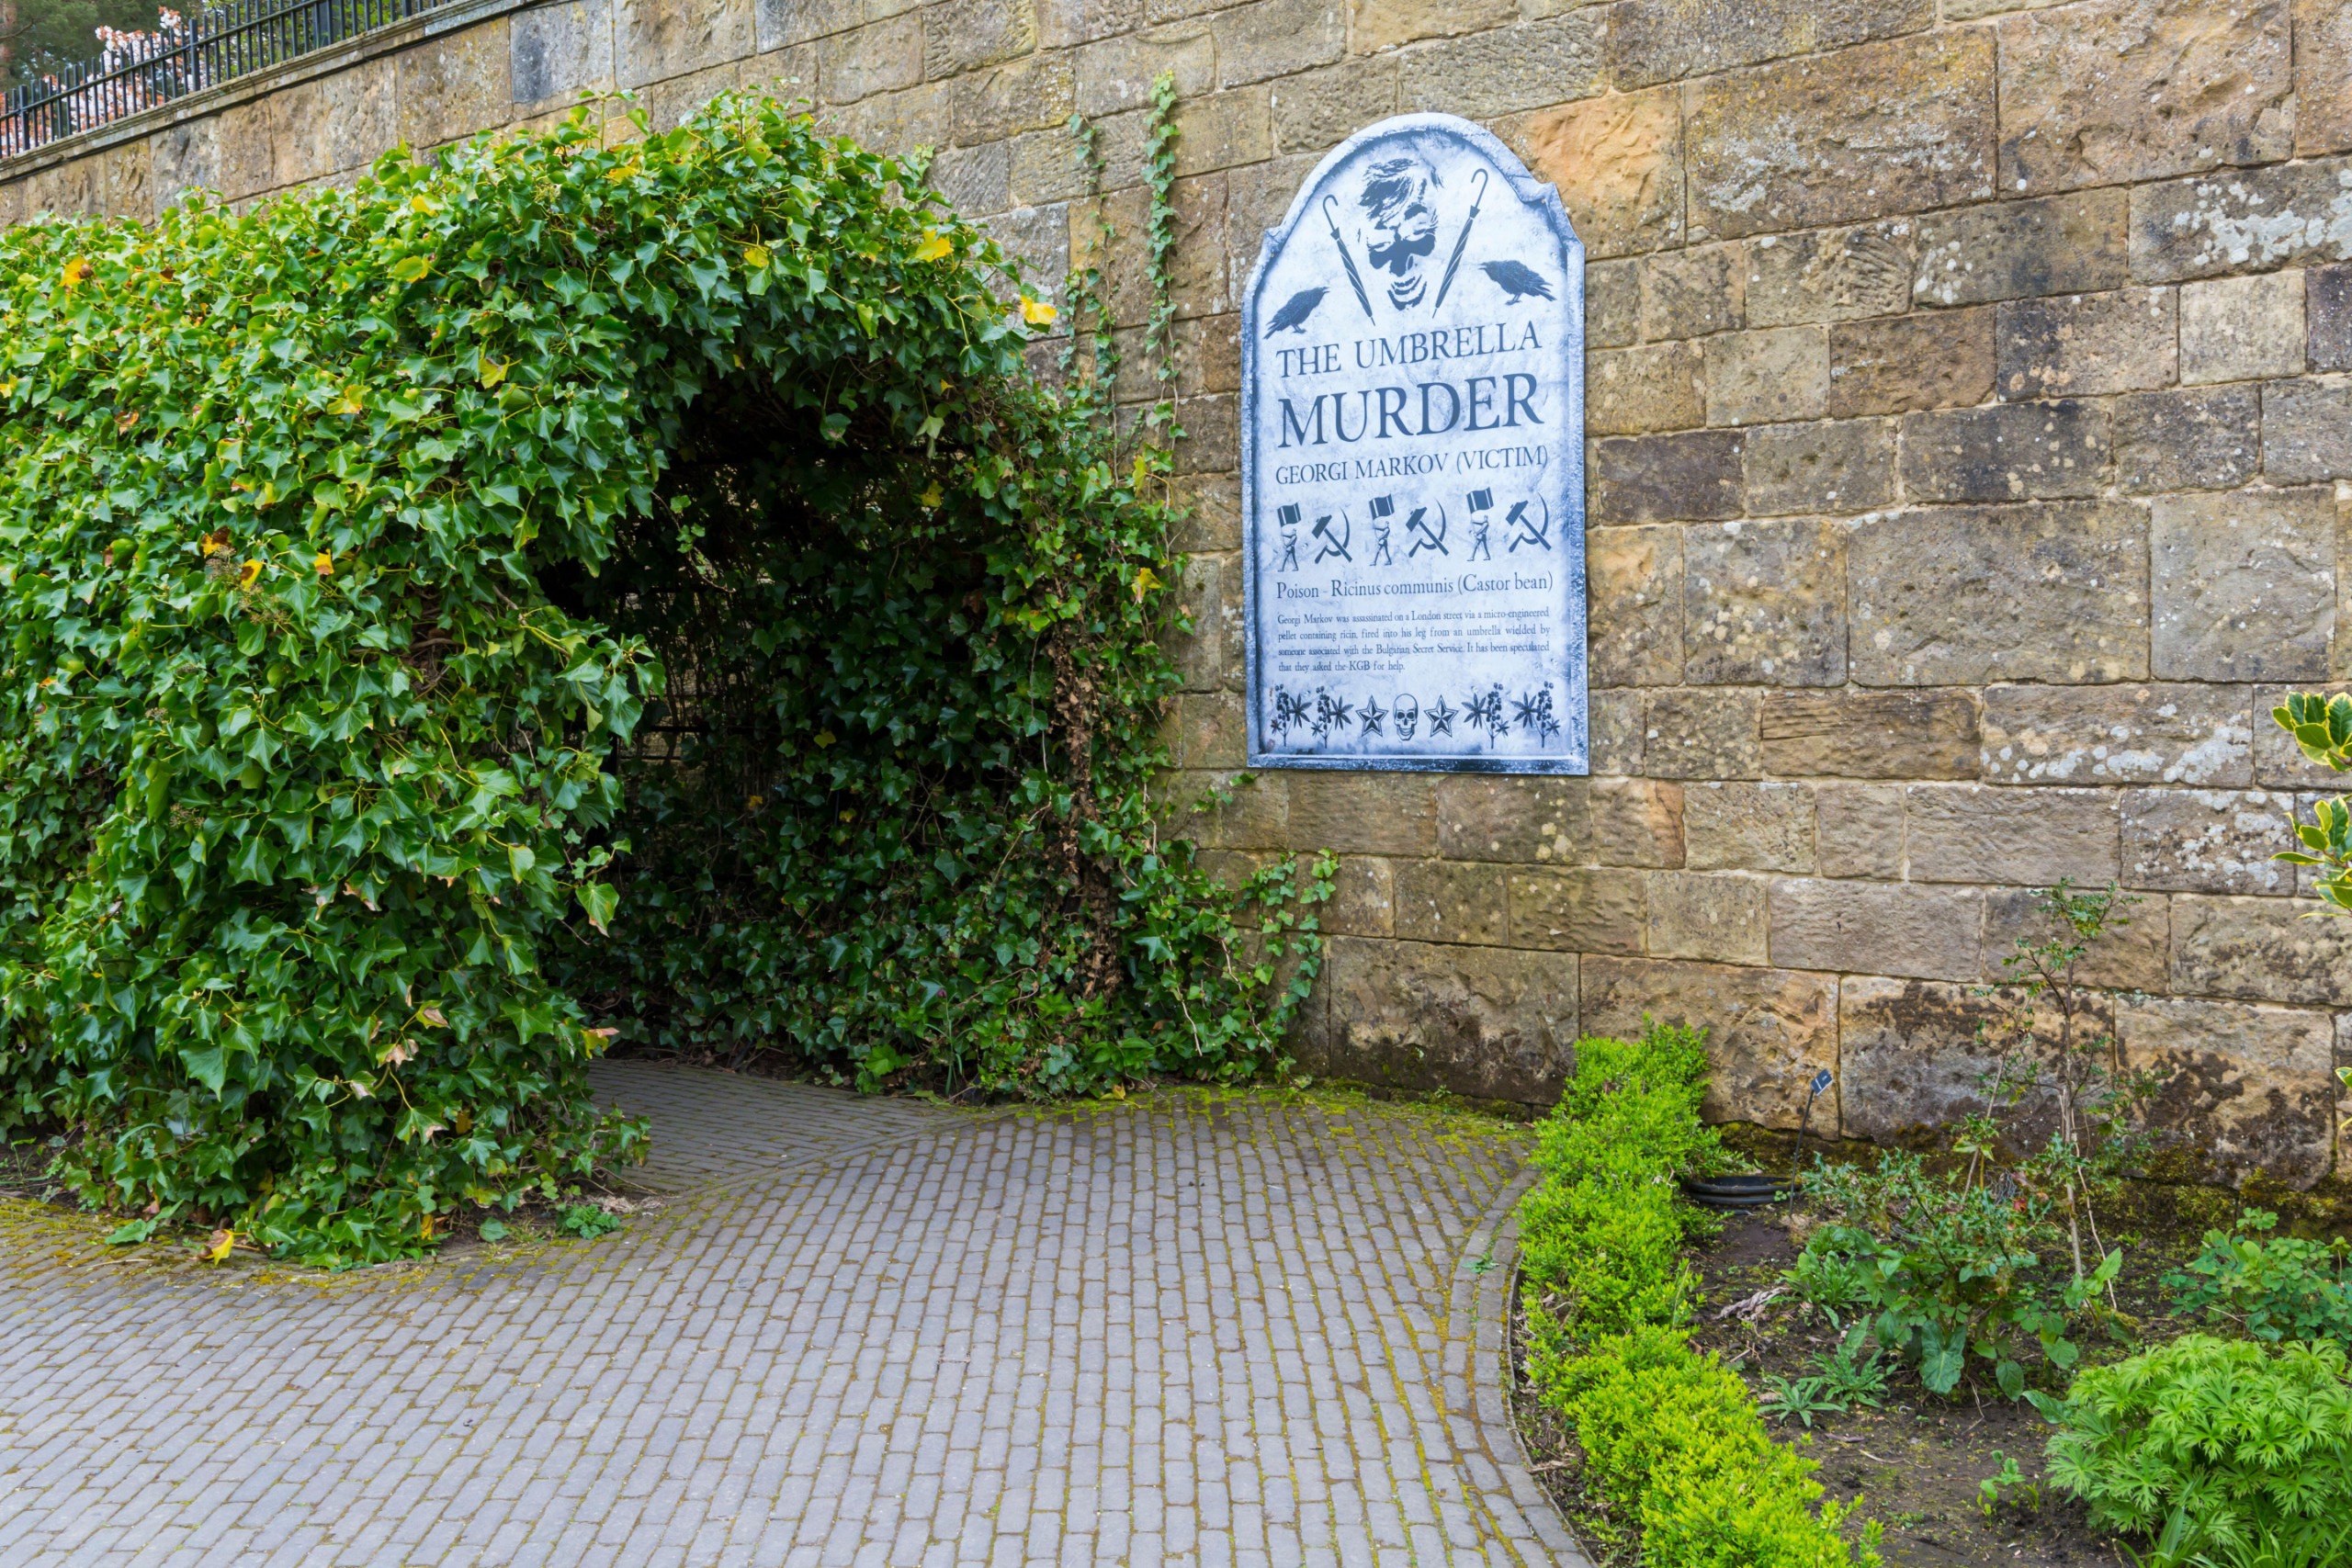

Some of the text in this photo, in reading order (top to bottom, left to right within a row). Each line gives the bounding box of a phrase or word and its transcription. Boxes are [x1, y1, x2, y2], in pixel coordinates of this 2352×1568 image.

[1276, 321, 1542, 378] THE UMBRELLA
[1277, 372, 1544, 448] MURDER
[1275, 445, 1548, 485] GEORGI MARKOV (VICTIM)
[1276, 581, 1319, 599] Poison
[1330, 579, 1381, 597] Ricinus
[1384, 577, 1453, 594] communis
[1458, 573, 1510, 595] (Castor
[1514, 570, 1553, 592] bean)
[1277, 614, 1301, 626] Georgi
[1304, 614, 1333, 624] Markov
[1352, 612, 1393, 622] assassinated
[1411, 610, 1442, 621] London
[1443, 611, 1463, 619] street
[1464, 610, 1476, 619] via
[1484, 606, 1550, 621] micro-engineered
[1278, 630, 1297, 642] pellet
[1299, 631, 1337, 641] containing
[1362, 628, 1379, 638] fired
[1383, 629, 1397, 637] into
[1401, 627, 1412, 637] his
[1415, 626, 1426, 639] leg
[1430, 626, 1450, 637] from
[1466, 625, 1501, 636] umbrella
[1505, 624, 1536, 635] wielded
[1540, 624, 1551, 636] by
[1308, 645, 1340, 656] associated
[1343, 646, 1359, 654] with
[1362, 645, 1374, 654] the
[1376, 644, 1410, 656] Bulgarian
[1412, 643, 1434, 653] Secret
[1437, 643, 1465, 653] Service.
[1467, 642, 1474, 652] It
[1476, 642, 1488, 652] has
[1490, 641, 1508, 651] been
[1510, 641, 1550, 654] speculated
[1278, 660, 1406, 673] that they asked the KGB for help.
